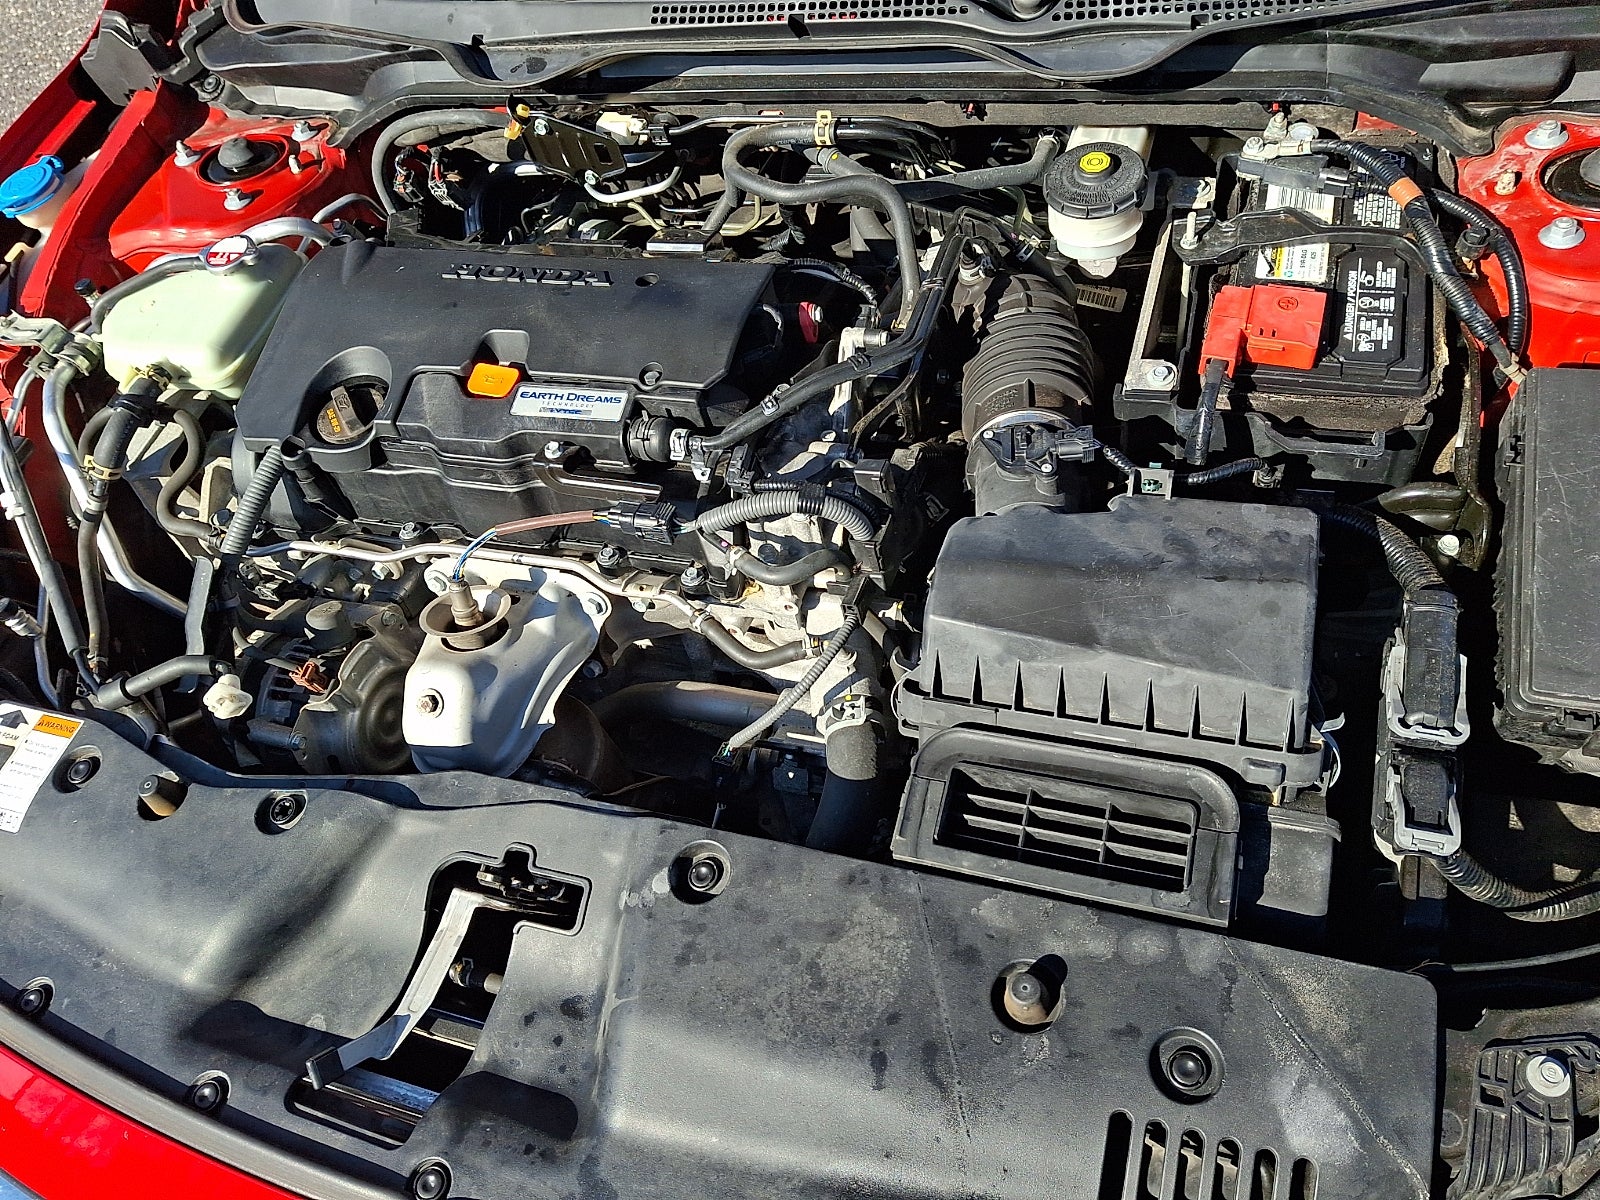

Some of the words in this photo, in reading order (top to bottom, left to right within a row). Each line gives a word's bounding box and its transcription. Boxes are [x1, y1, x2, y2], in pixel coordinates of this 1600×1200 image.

[441, 263, 614, 287] HONDA
[1347, 270, 1358, 297] POISON
[1344, 302, 1356, 333] DANGER
[520, 391, 564, 401] EARTH
[566, 393, 622, 404] DREAMS
[43, 720, 76, 734] WARNING
